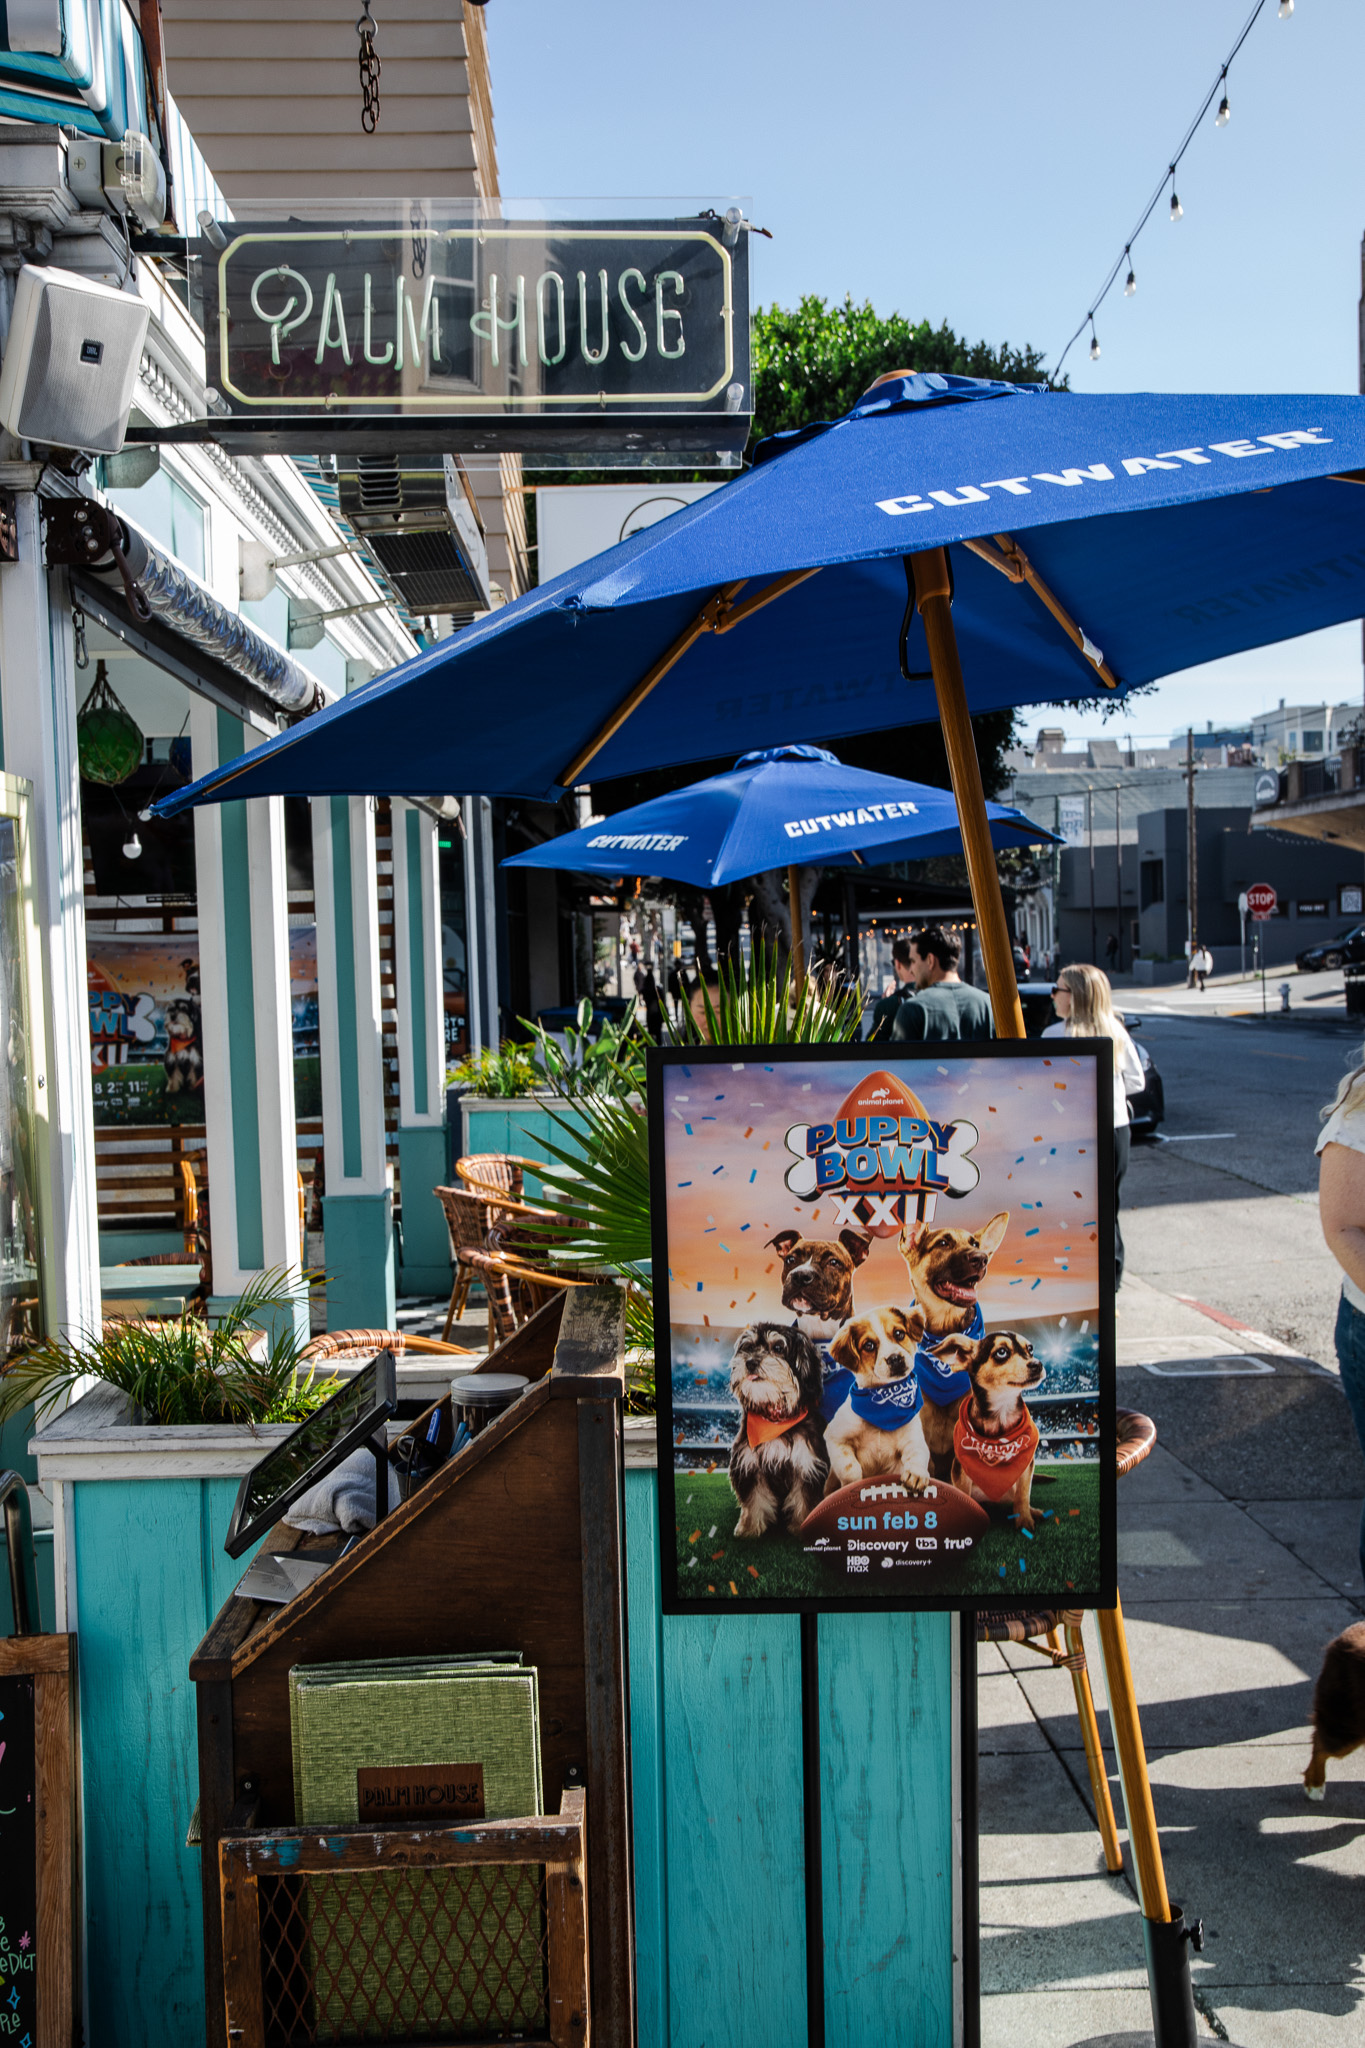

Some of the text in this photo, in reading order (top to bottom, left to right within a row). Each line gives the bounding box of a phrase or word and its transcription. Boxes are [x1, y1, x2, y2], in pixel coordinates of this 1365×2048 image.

[250, 267, 685, 370] PALM HOUSE
[784, 801, 920, 838] CUTWATER
[1248, 893, 1274, 905] STOP
[857, 1097, 904, 1107] animal planet
[806, 1116, 958, 1157] PUPPY
[815, 1146, 950, 1192] BOWL
[829, 1193, 938, 1226] XXII
[837, 1511, 938, 1531] sun feb 8
[847, 1539, 909, 1552] Discovery
[847, 1555, 870, 1565] HBO
[847, 1565, 869, 1573] max
[362, 1782, 480, 1808] PALM HOUSE
